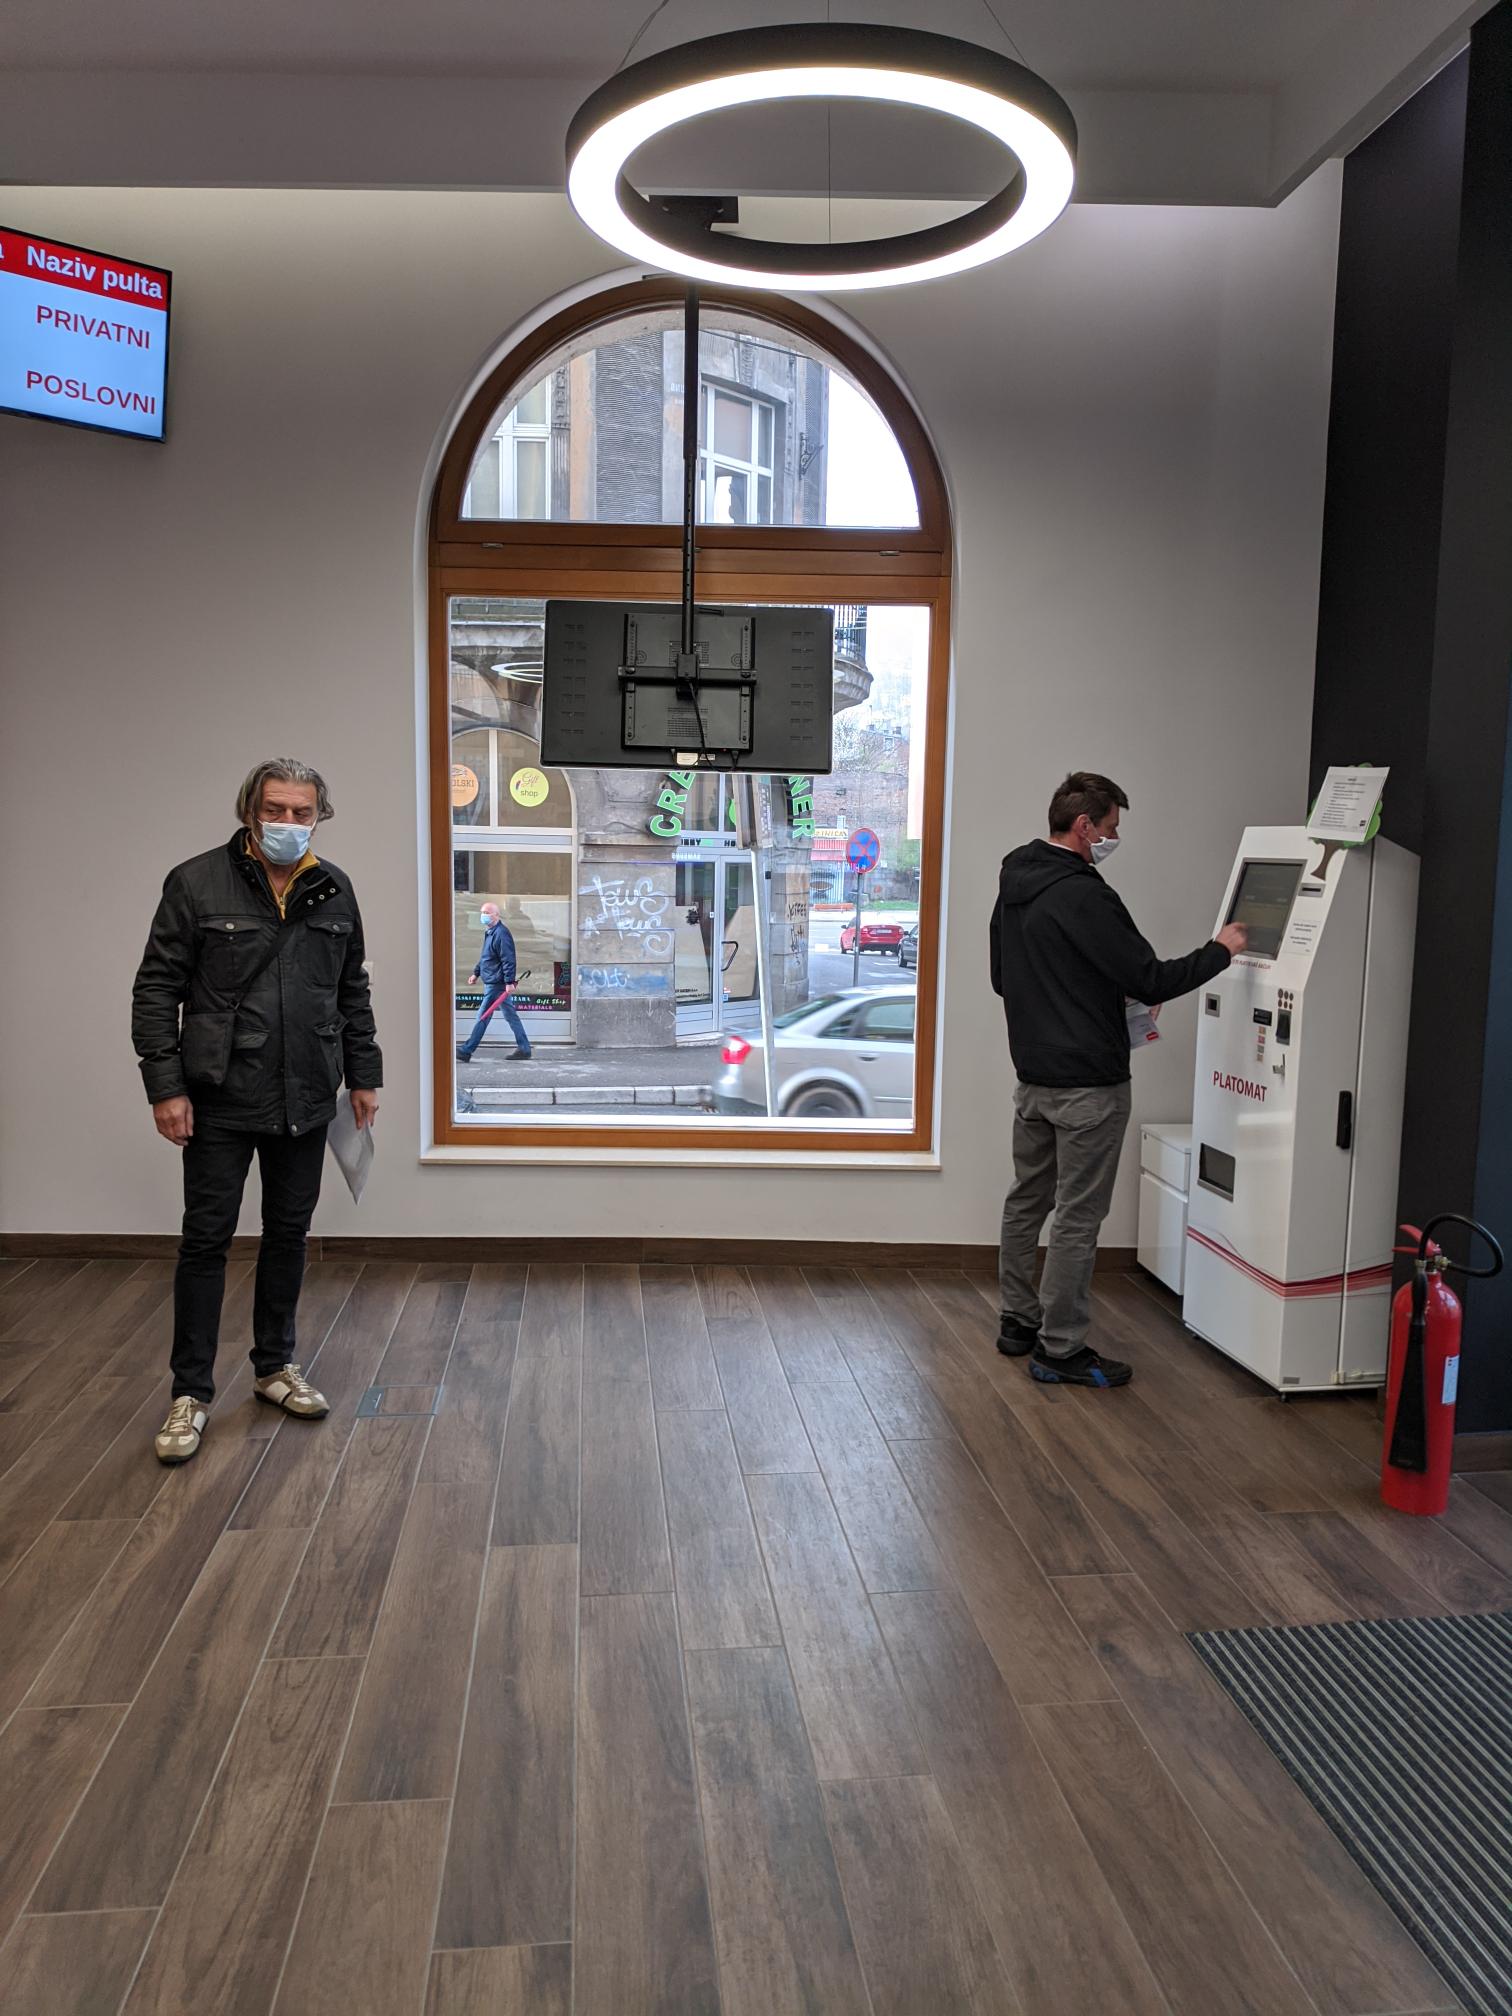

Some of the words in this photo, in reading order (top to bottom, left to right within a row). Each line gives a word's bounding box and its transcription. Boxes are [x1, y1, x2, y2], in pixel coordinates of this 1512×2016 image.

[27, 245, 96, 281] Naziv
[103, 268, 163, 300] pulta
[36, 304, 151, 349] PRIVATNI
[26, 370, 156, 415] POSLOVNI
[1213, 1070, 1267, 1102] PLATOMAT
